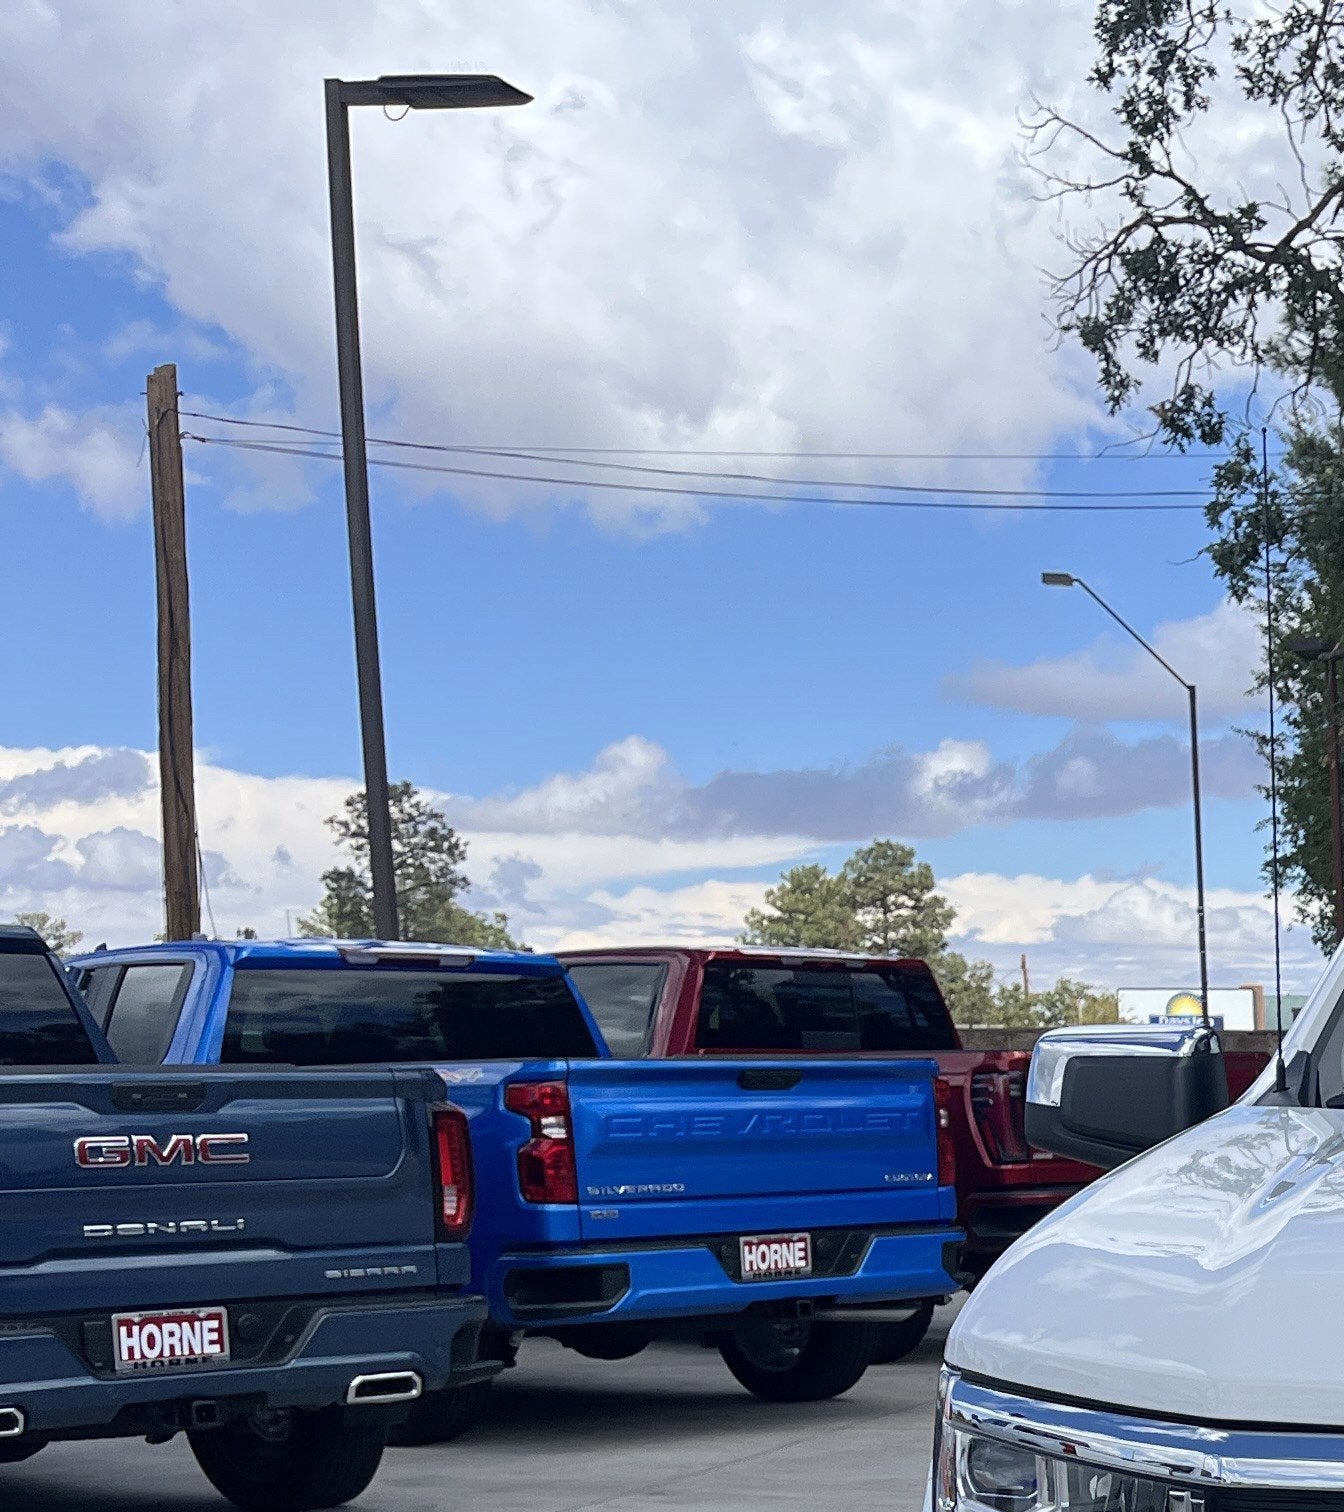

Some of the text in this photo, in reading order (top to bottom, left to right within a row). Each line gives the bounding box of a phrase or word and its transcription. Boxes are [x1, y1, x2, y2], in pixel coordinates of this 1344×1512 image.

[608, 1112, 920, 1137] CHEVROLET
[73, 1133, 250, 1169] GMC
[587, 1183, 685, 1196] SILVERADO
[83, 1217, 245, 1237] DENALI
[743, 1241, 807, 1272] HORNE
[324, 1265, 418, 1279] SIERRA
[119, 1319, 221, 1361] HORNE
